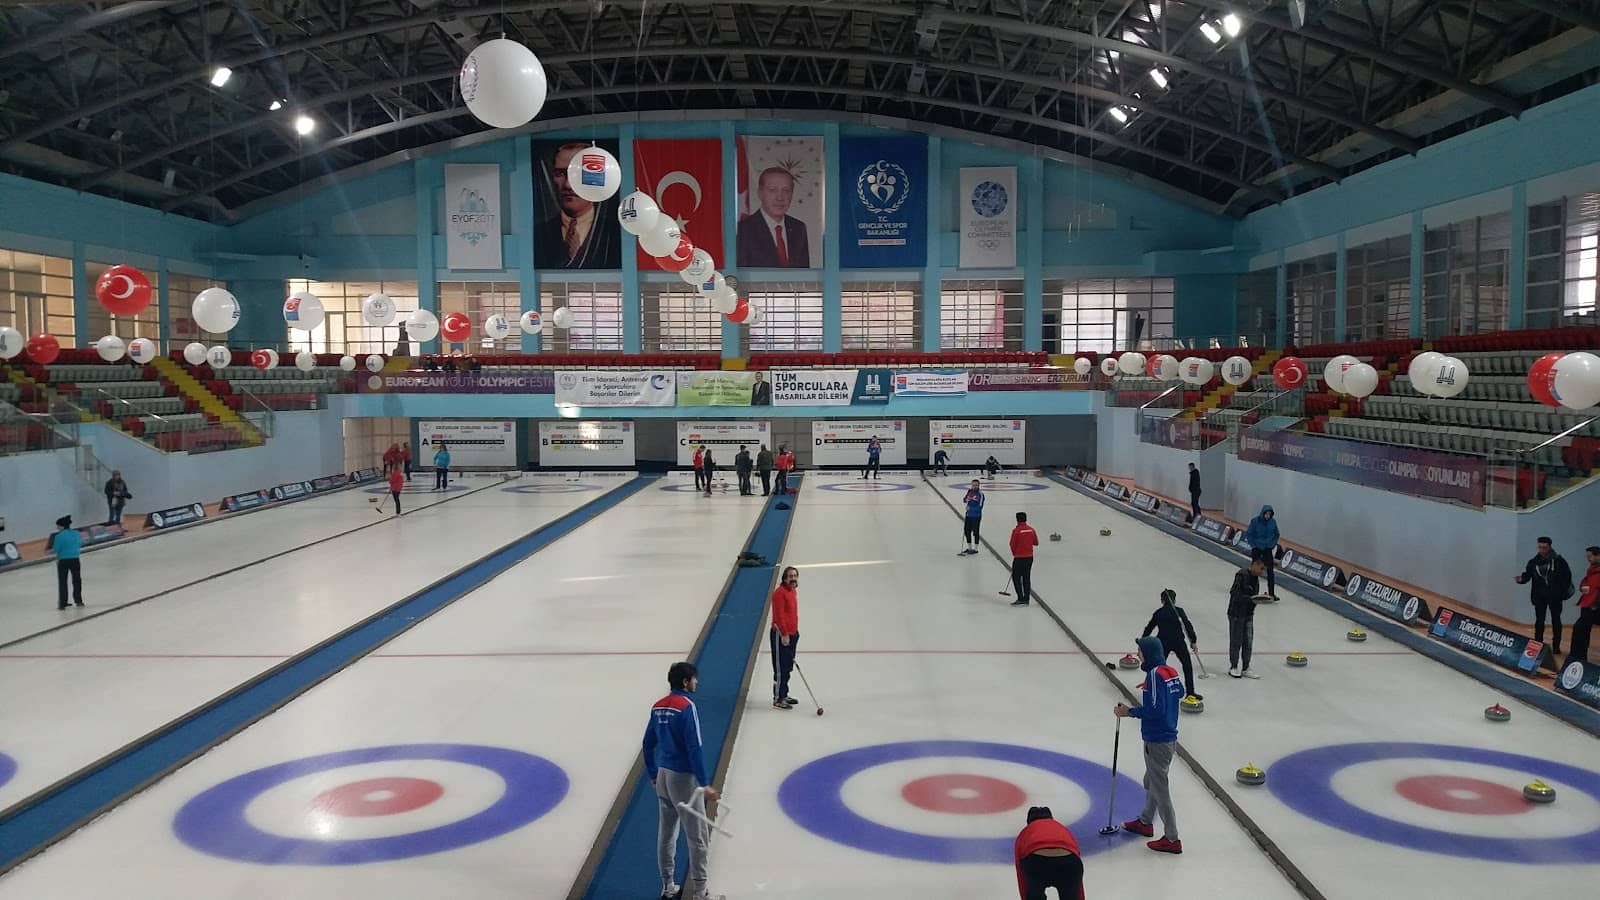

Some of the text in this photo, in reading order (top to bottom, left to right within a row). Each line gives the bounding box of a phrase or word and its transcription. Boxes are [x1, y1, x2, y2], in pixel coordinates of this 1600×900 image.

[775, 371, 797, 381] TÜM
[775, 381, 849, 391] SPORCULARA
[422, 438, 430, 446] A
[542, 438, 549, 446] B
[680, 438, 687, 446] C
[815, 438, 823, 446] D
[933, 437, 939, 445] E
[1364, 580, 1402, 604] ERZURUM
[1458, 619, 1514, 648] TÜRKİYE CURLING
[1458, 633, 1504, 657] FEDERASYONU
